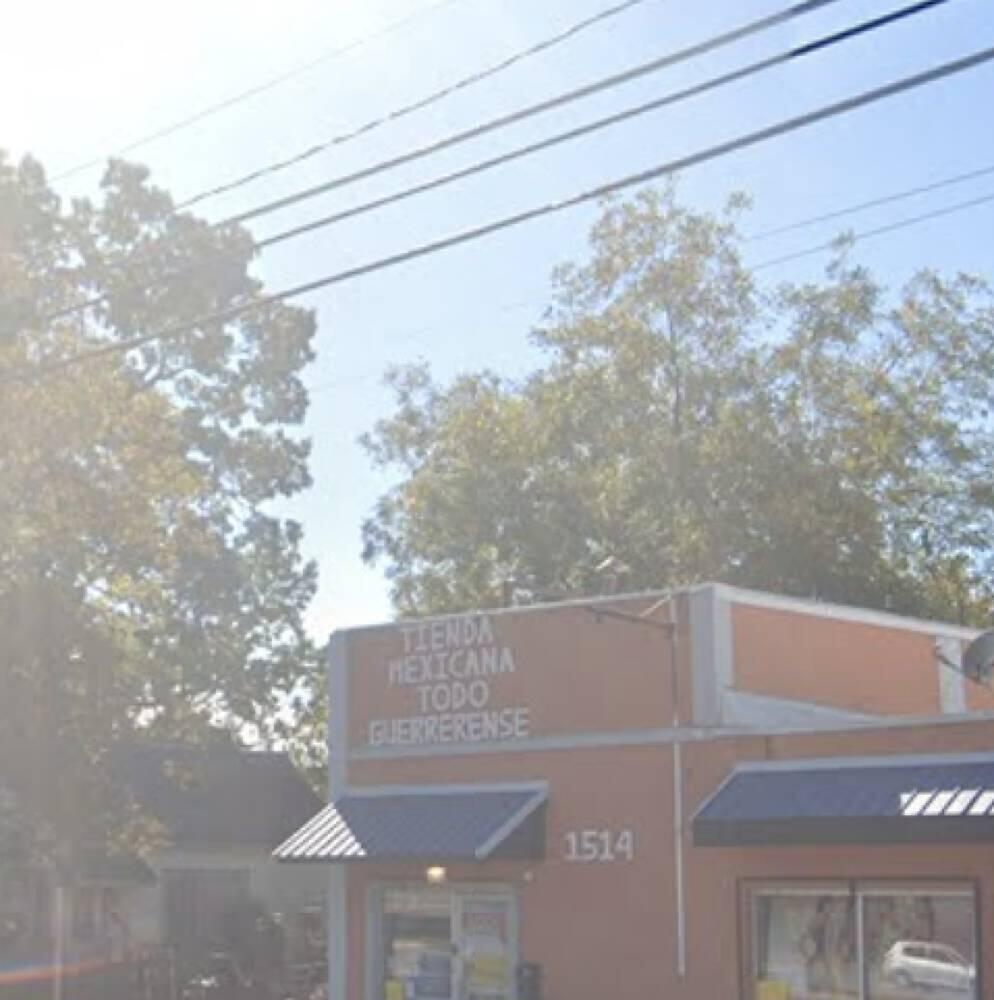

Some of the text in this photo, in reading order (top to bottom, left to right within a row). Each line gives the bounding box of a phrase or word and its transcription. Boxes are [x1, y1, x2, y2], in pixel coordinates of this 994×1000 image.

[401, 614, 494, 651] TIENDA
[389, 649, 516, 685] MEXICANA
[417, 681, 490, 712] TODO
[368, 708, 530, 744] GUERRERENSE
[565, 831, 634, 861] 1514
